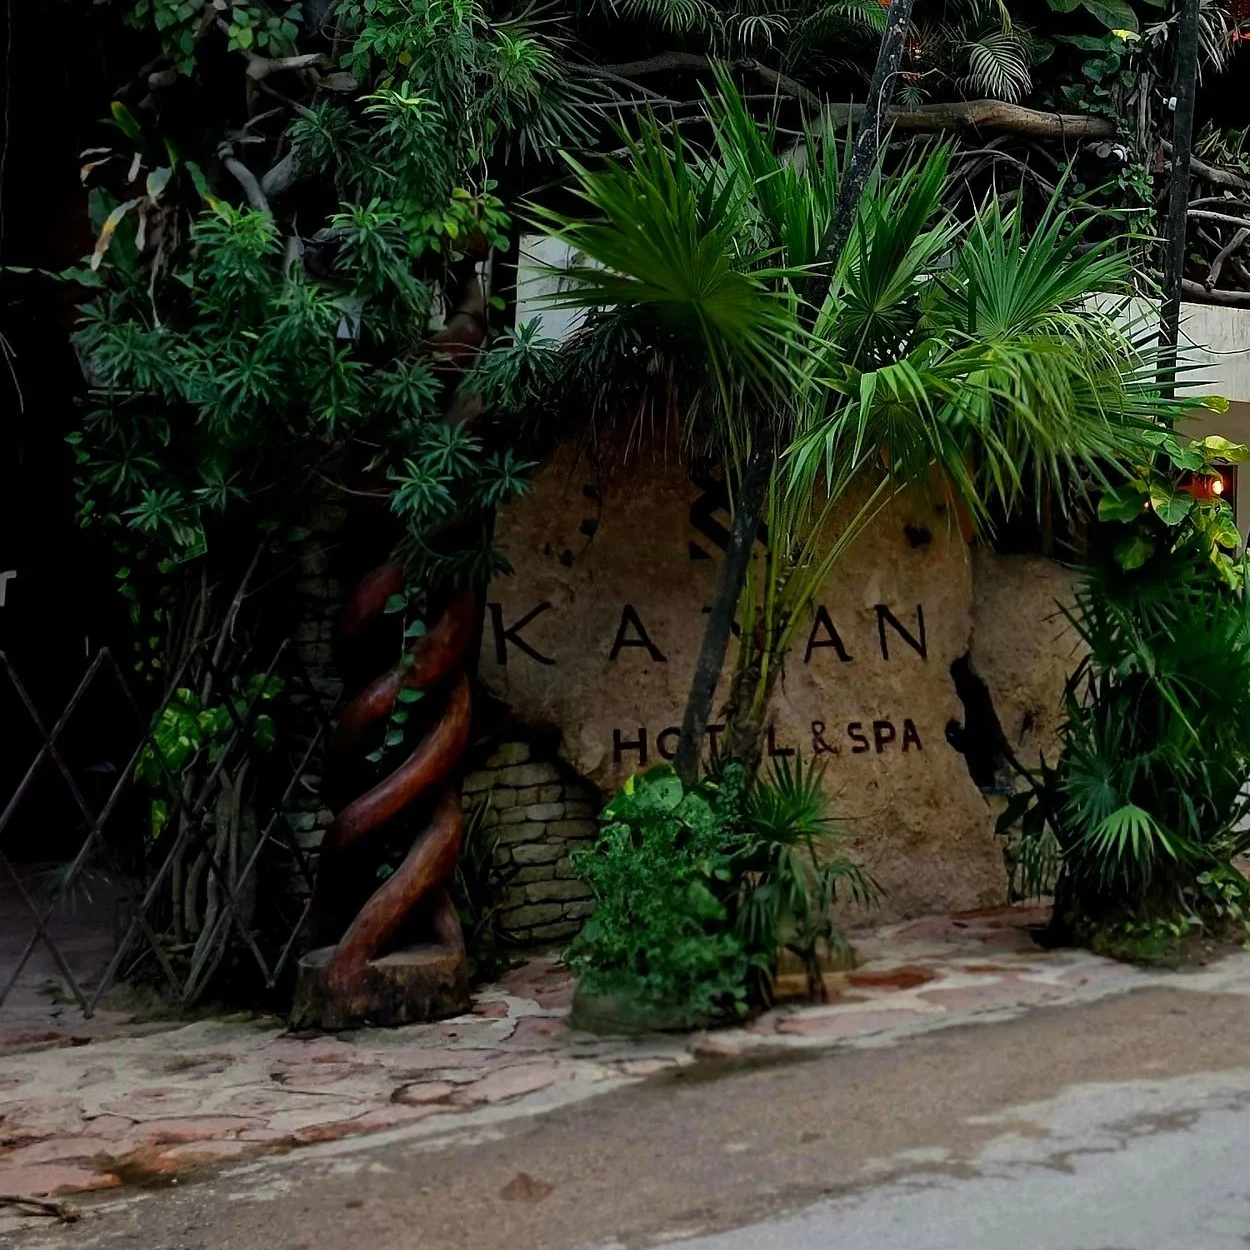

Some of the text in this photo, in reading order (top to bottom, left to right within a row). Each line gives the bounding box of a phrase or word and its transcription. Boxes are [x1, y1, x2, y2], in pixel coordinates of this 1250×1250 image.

[487, 603, 928, 664] KAAN
[613, 718, 922, 766] HOTL & SPA
